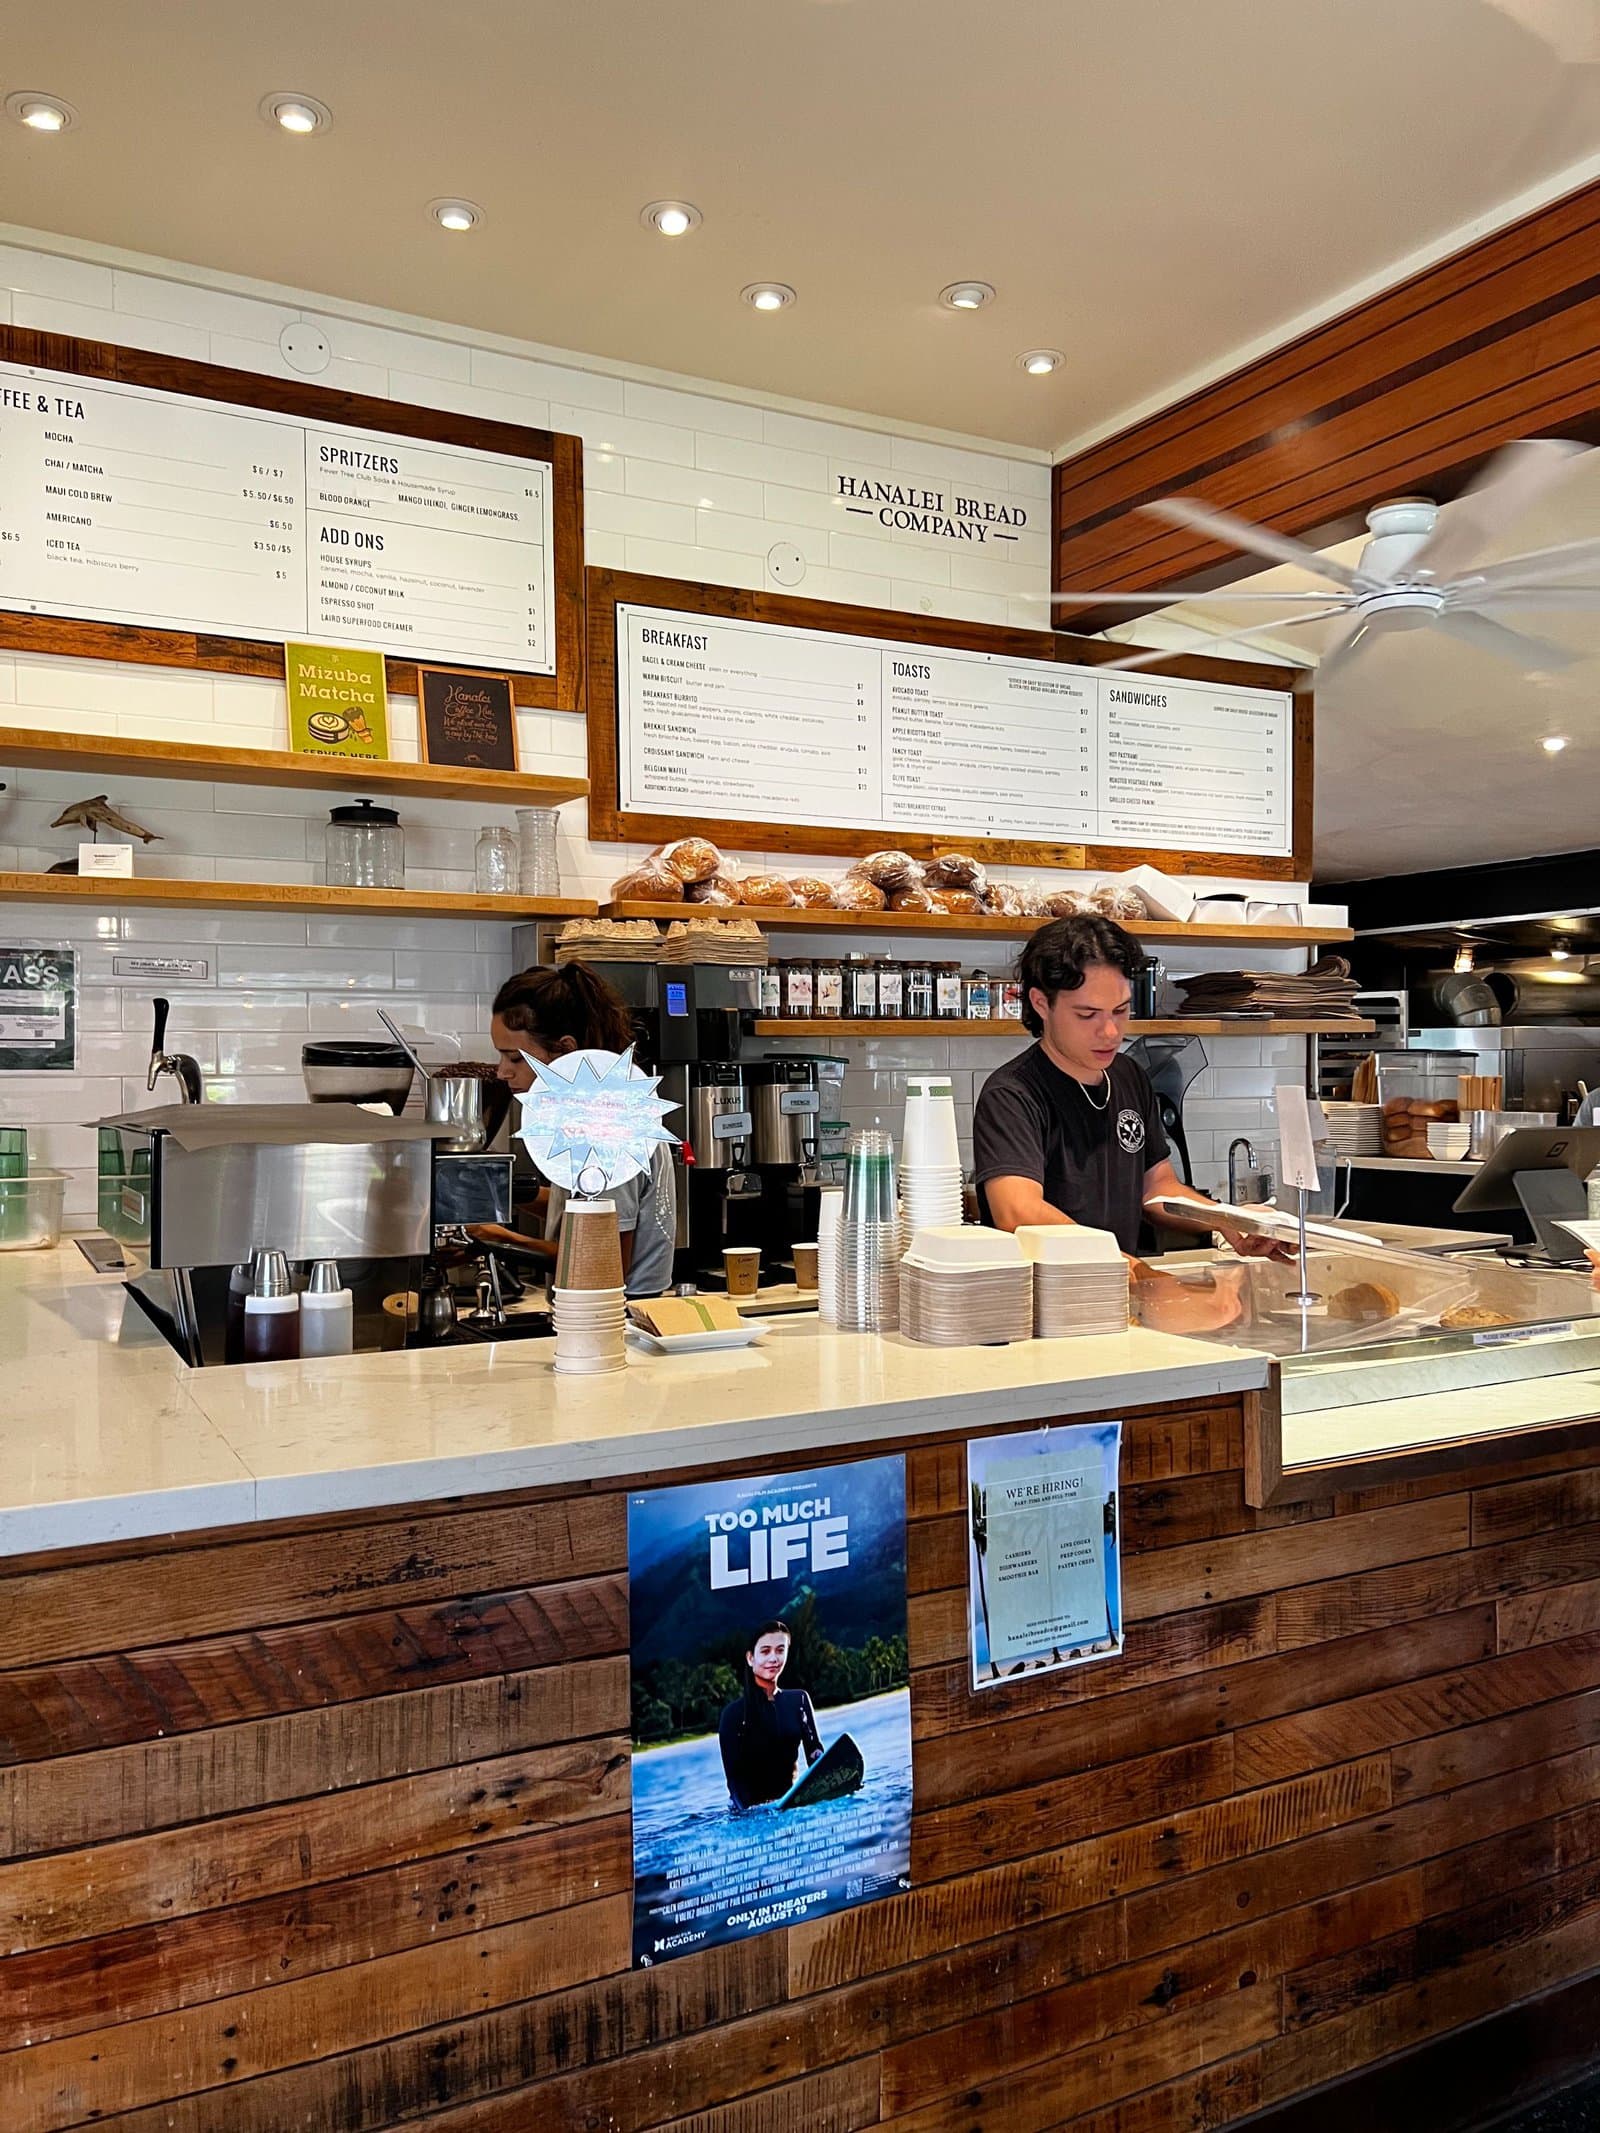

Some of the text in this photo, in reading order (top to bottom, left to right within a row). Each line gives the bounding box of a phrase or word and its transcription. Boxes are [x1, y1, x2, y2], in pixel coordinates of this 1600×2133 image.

[0, 387, 83, 419] FEE & TEA
[44, 430, 72, 443] MOCHA
[45, 457, 103, 475] CHAI MATCHA
[320, 445, 398, 474] SPRITZERS
[319, 466, 337, 475] Fever
[340, 470, 354, 478] Tree
[356, 473, 371, 481] Club
[373, 476, 389, 484] Soda
[437, 487, 455, 495] Syrup
[45, 485, 66, 496] MAUI
[68, 488, 88, 499] COLD
[90, 492, 111, 503] BREW
[319, 492, 369, 508] BLOOD ORANGE
[838, 476, 1026, 526] HANALEI BREAD
[398, 494, 422, 504] MANGO
[451, 502, 474, 513] GINGER
[46, 511, 91, 526] AMERICANO
[879, 508, 988, 542] COMPANY
[46, 538, 64, 549] ICED
[66, 541, 79, 551] TEA
[320, 526, 383, 550] ADD ONS
[86, 558, 116, 569] hibiscus
[320, 554, 343, 564] HOUSE
[344, 557, 371, 568] SYRUPS
[320, 579, 348, 590] ALMOND
[355, 584, 386, 595] COCONUT
[388, 589, 404, 598] MILK
[320, 596, 355, 608] ESPRESSO
[357, 601, 373, 610] SHOT
[342, 616, 381, 628] SUPERFOOD
[382, 621, 412, 632] CREAMER
[642, 628, 708, 651] BREAKFAST
[642, 656, 658, 664] BAGEL
[666, 658, 684, 668] CREAM
[685, 661, 705, 670] CHEESE
[893, 662, 930, 679] TOASTS
[298, 664, 372, 685] Mizuba
[642, 673, 659, 681] WARM
[660, 675, 682, 684] BISCUIT
[300, 684, 375, 704] Matcha
[643, 690, 697, 702] BREAKFAST BURRITO
[892, 687, 928, 697] AVOCADO TOAST
[1110, 690, 1167, 708] SANDWICHES
[892, 707, 943, 718] PEANUT BUTTER TOAST
[667, 724, 696, 734] SANDWICH
[928, 730, 941, 738] TOAST
[644, 747, 674, 756] CROISSANT
[676, 750, 704, 759] SANDWICH
[908, 749, 922, 757] TOAST
[644, 764, 666, 772] BELGIAN
[1006, 1477, 1083, 1499] WE'RE HIRING!
[705, 1497, 831, 1533] TOO MUCH
[1074, 1538, 1090, 1546] COOKS
[710, 1515, 849, 1590] LIFE
[1005, 1550, 1031, 1560] CASHIERS
[1000, 1560, 1037, 1571] DISHWASHERS
[1078, 1558, 1094, 1566] CHEFS
[998, 1569, 1038, 1582] SMOOTHIE BAR
[727, 1889, 828, 1927] ONLY IN THEATERS
[747, 1905, 807, 1930] AUGUST 19
[666, 1930, 706, 1949] ACADEMY
